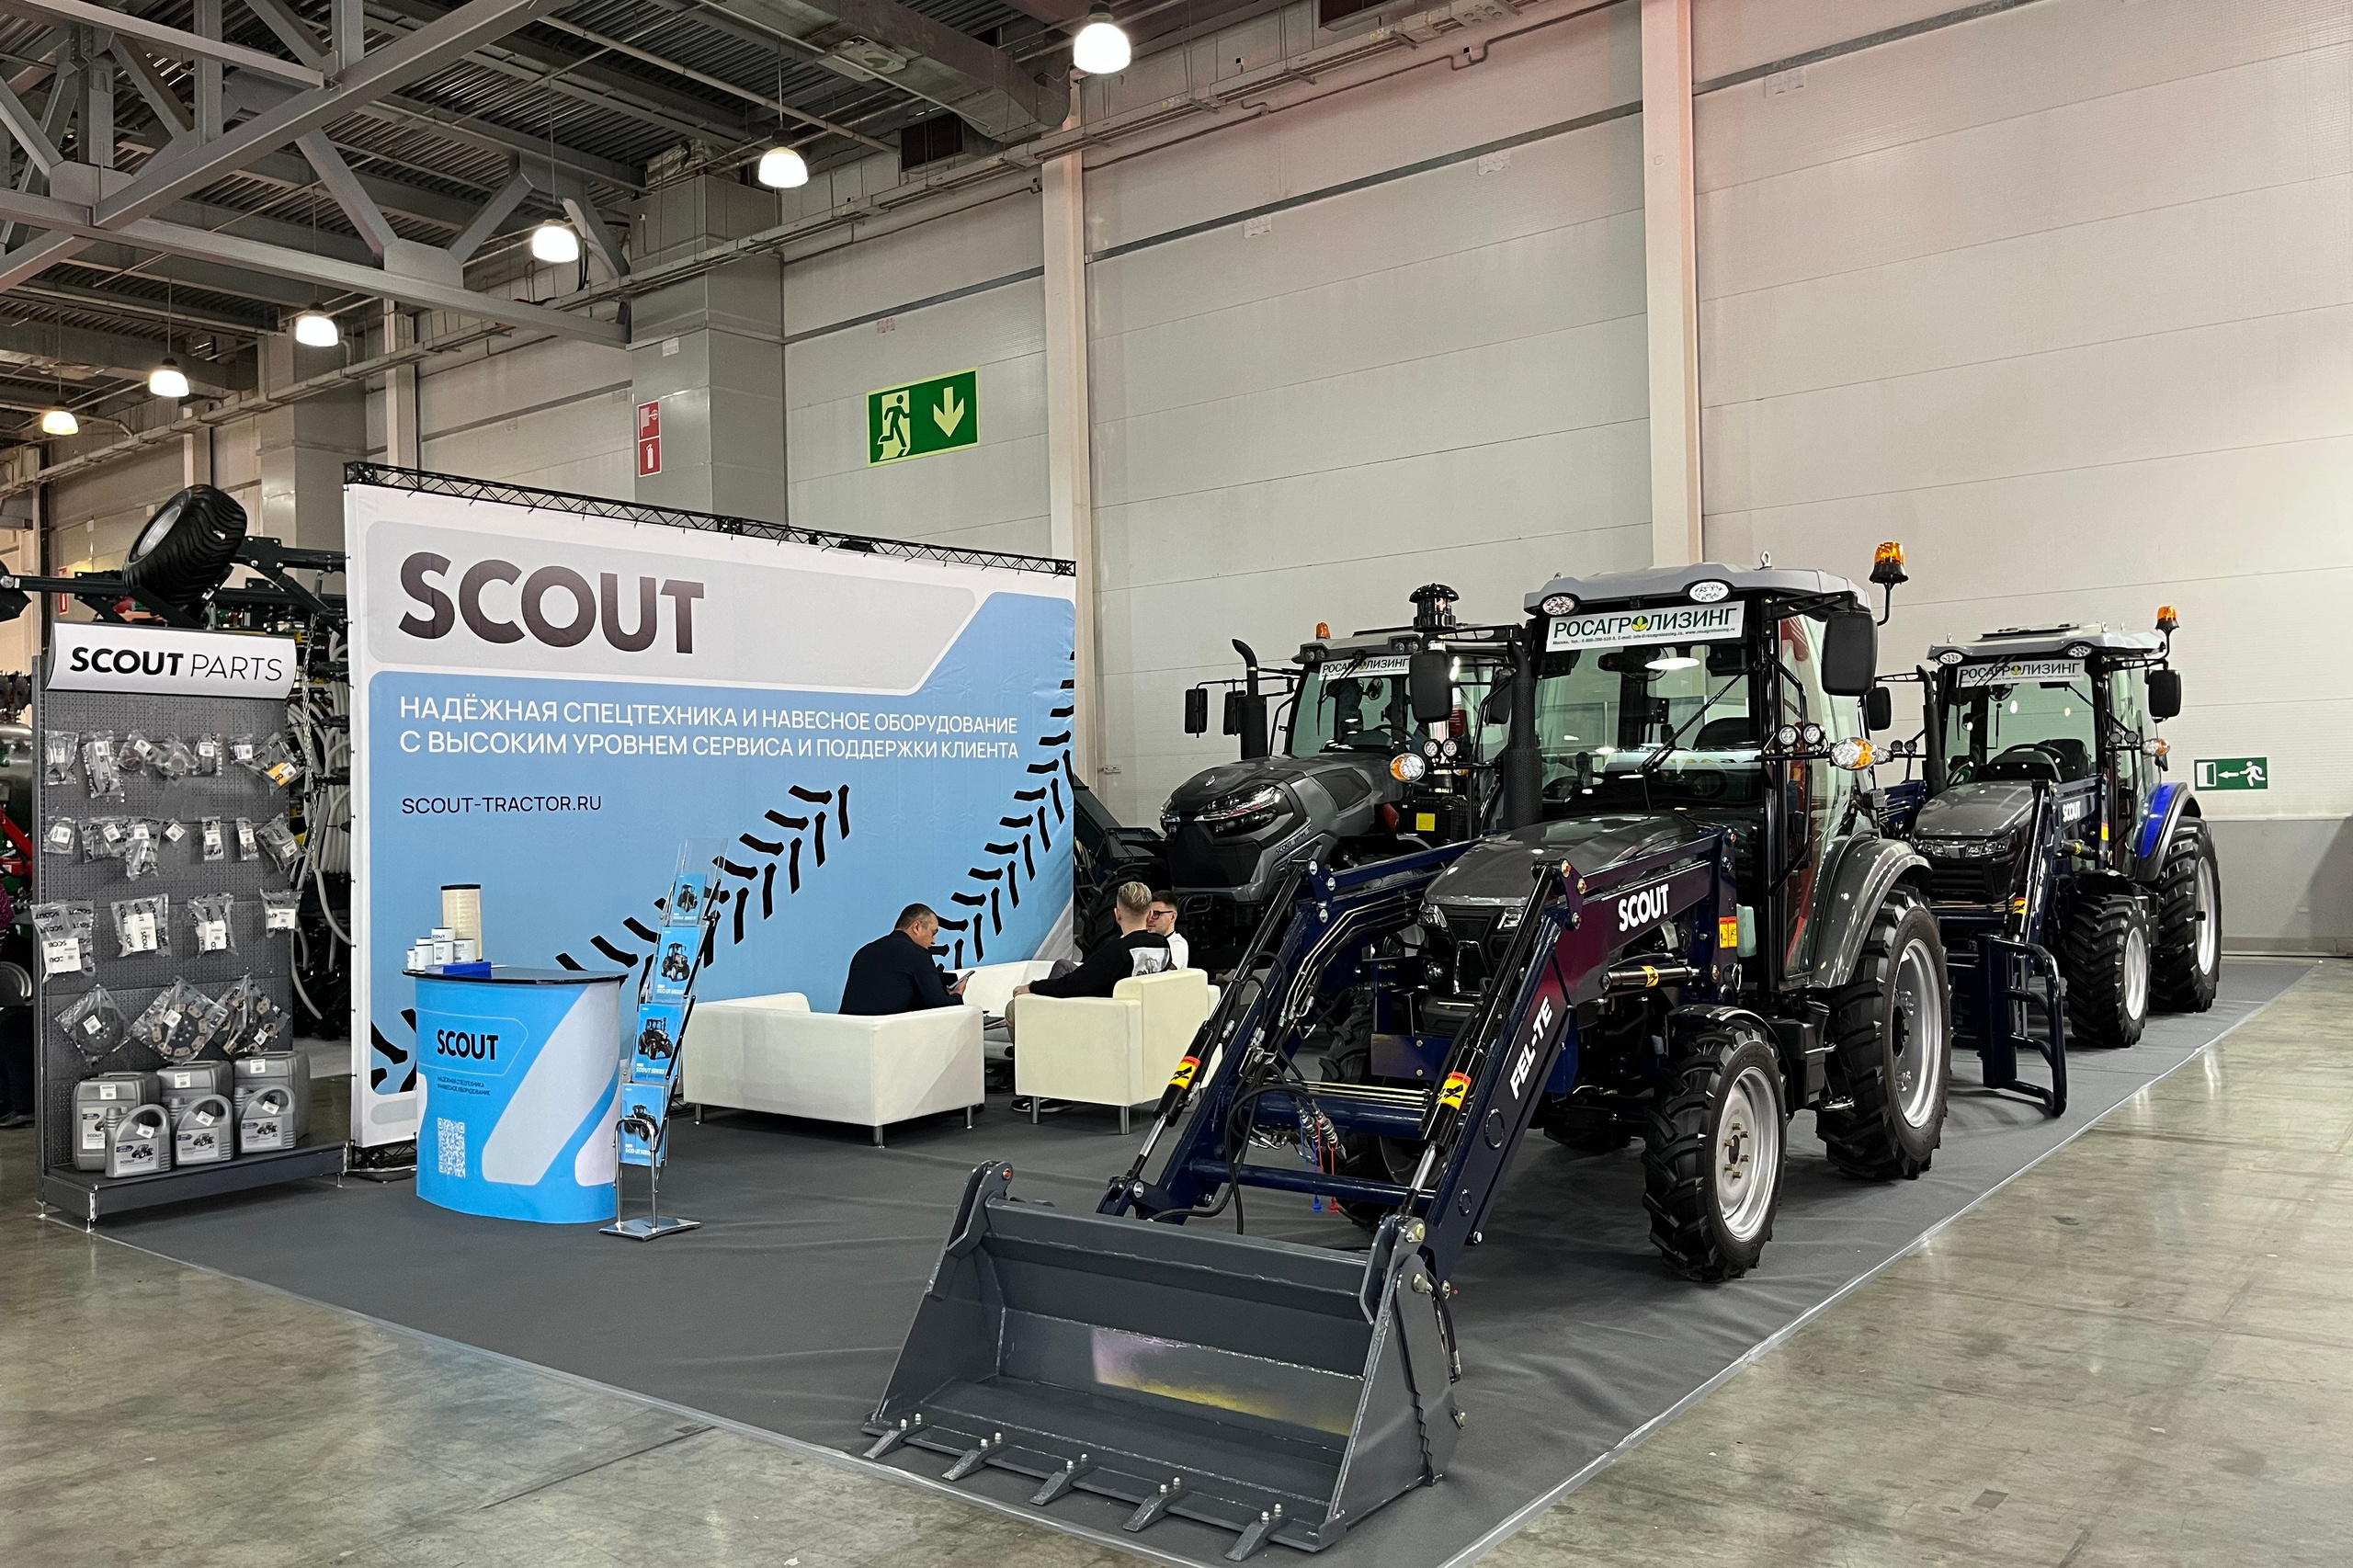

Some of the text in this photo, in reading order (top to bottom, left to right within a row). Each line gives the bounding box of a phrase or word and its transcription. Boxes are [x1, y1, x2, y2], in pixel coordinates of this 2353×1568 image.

[398, 551, 704, 654] SCOUT
[70, 646, 282, 681] SCOUT PARTS
[400, 692, 1017, 734] НАДЁЖНАЯ СПЕЦТЕХНИКА И НАВЕСНОЕ ОБОРУДОВАНИЕ
[400, 730, 1019, 760] С ВЫСОКИМ УРОВНЕМ СЕРВИСА И ПОДДЕРЖКИ КЛИЕНТА
[402, 795, 602, 814] SCOUT-TRACTOR.RU
[2063, 800, 2081, 823] SCOUT
[1619, 883, 1669, 932] SCOUT
[437, 1028, 499, 1061] SCOUT
